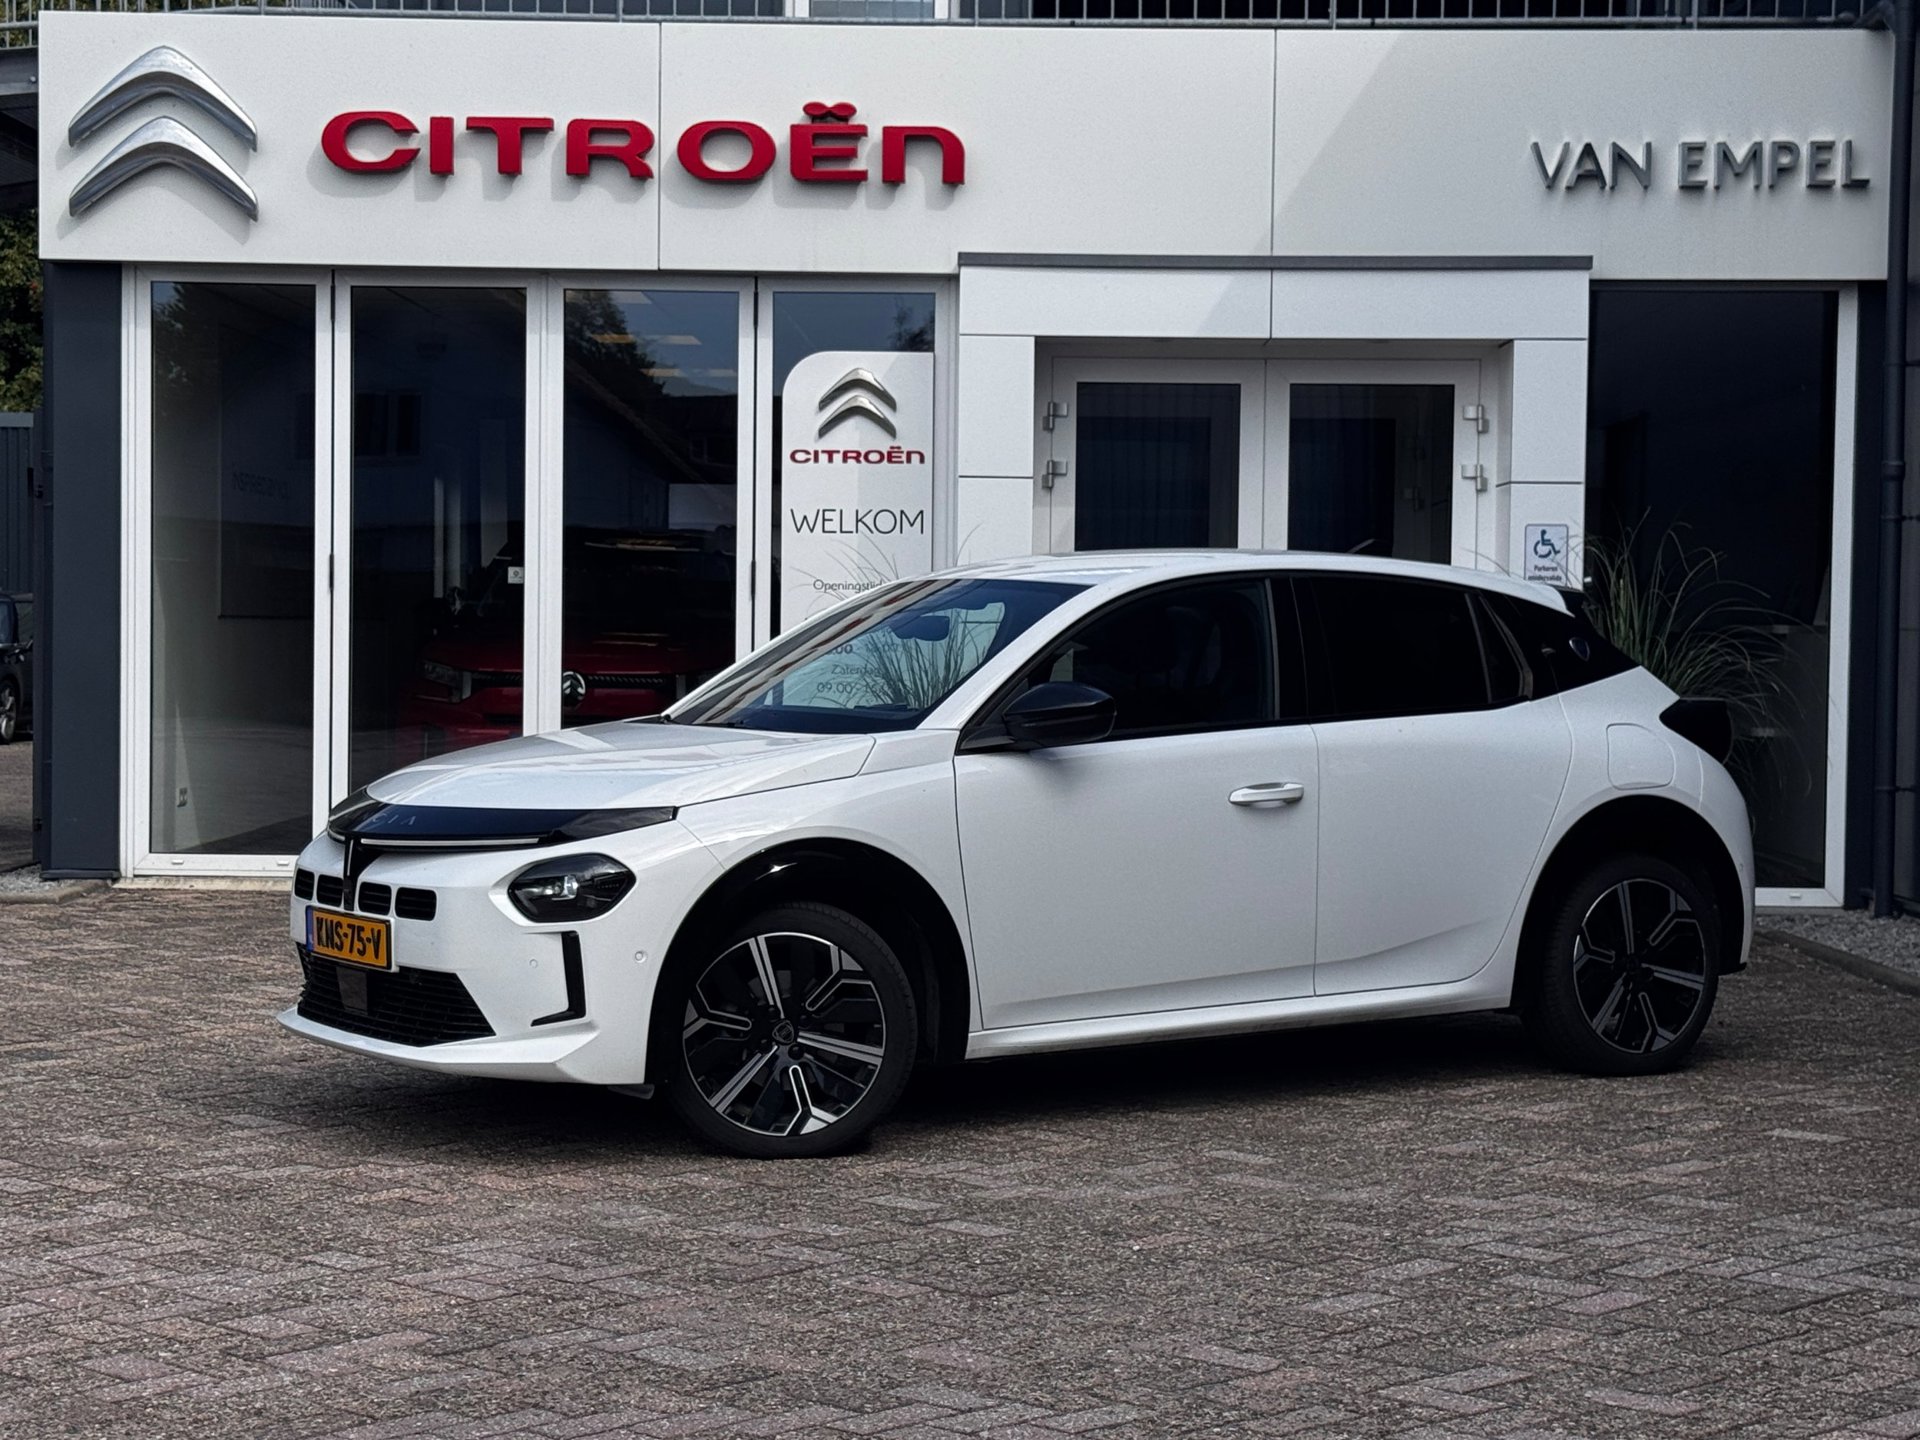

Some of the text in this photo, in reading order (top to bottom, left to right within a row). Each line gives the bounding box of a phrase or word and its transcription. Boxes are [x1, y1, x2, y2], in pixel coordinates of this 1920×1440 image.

[1530, 139, 1871, 190] VAN EMPEL
[790, 508, 925, 535] WELKOM
[316, 917, 382, 960] KNS-75-V
